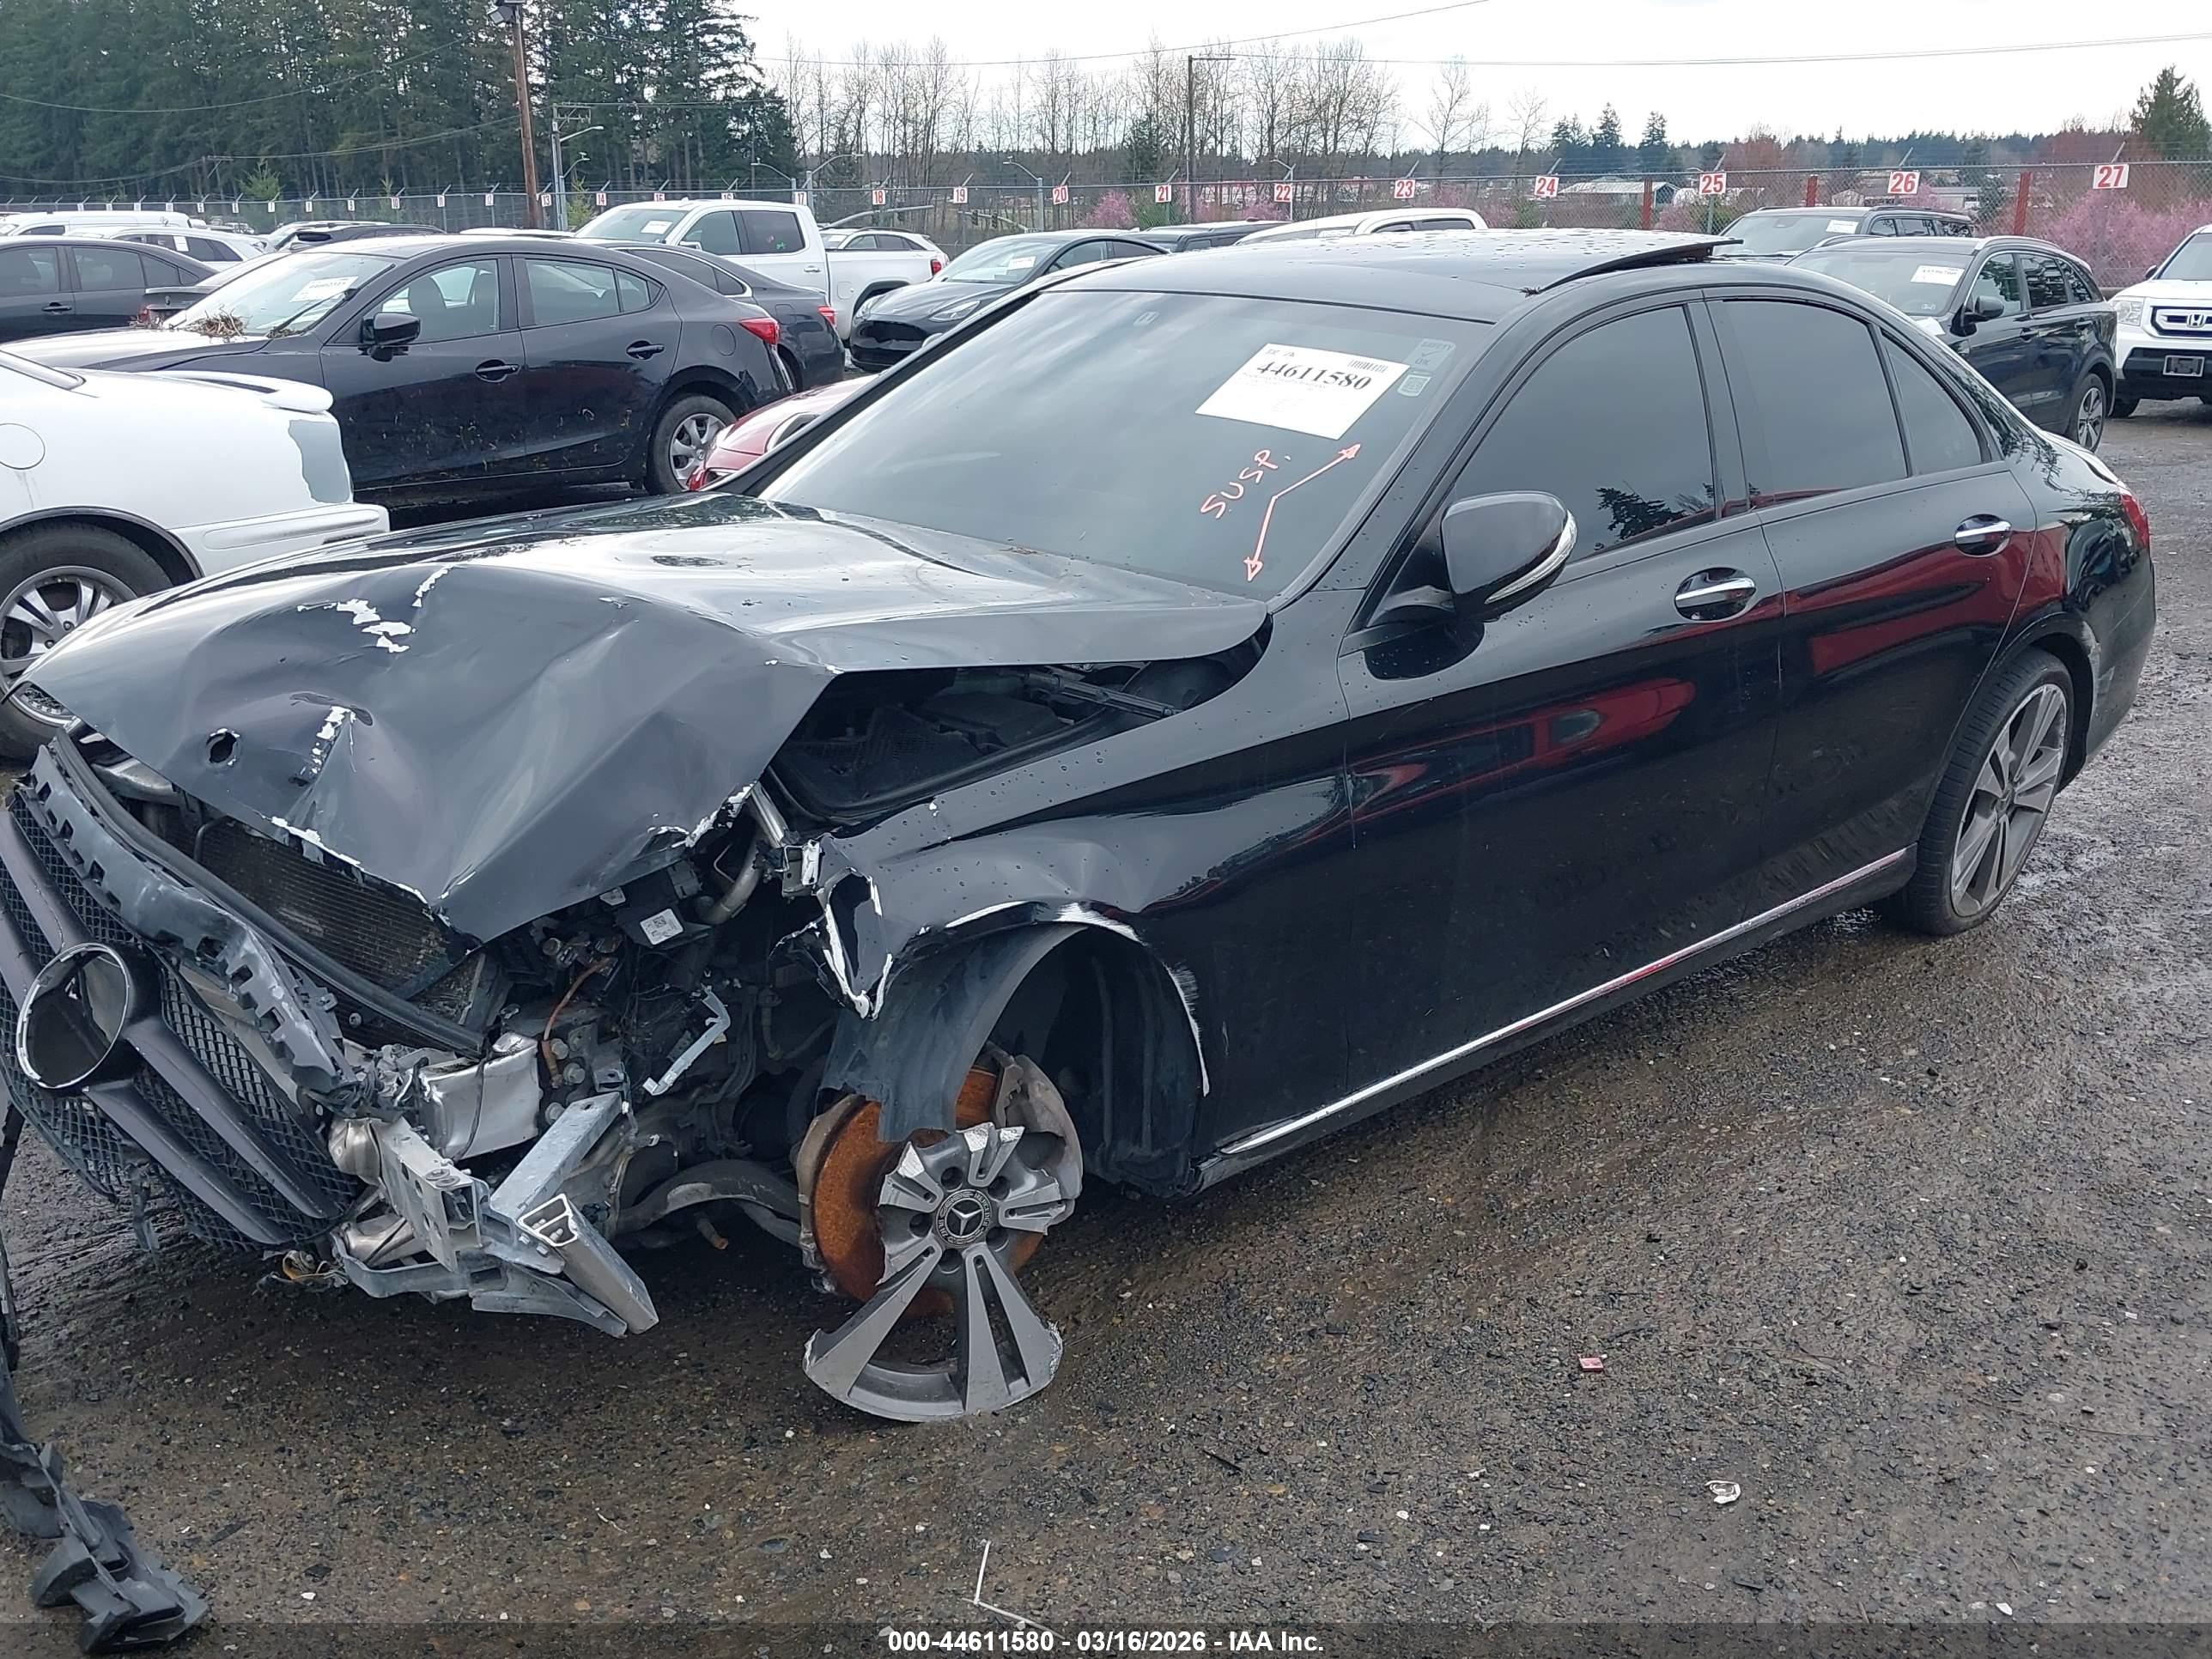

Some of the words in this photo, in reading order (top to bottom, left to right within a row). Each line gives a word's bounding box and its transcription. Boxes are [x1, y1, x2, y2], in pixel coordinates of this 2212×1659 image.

[1701, 174, 1724, 193] 25
[1890, 173, 1917, 193] 26
[2097, 165, 2124, 188] 27
[1054, 186, 1067, 203] 20
[1158, 185, 1170, 201] 21
[1275, 185, 1291, 200] 22
[1395, 180, 1413, 198] 23
[1535, 177, 1556, 196] 24
[543, 194, 550, 205] 13
[598, 193, 605, 204] 14
[797, 192, 805, 205] 17
[874, 191, 884, 204] 18
[956, 188, 966, 203] 19
[1256, 361, 1372, 391] 44611580
